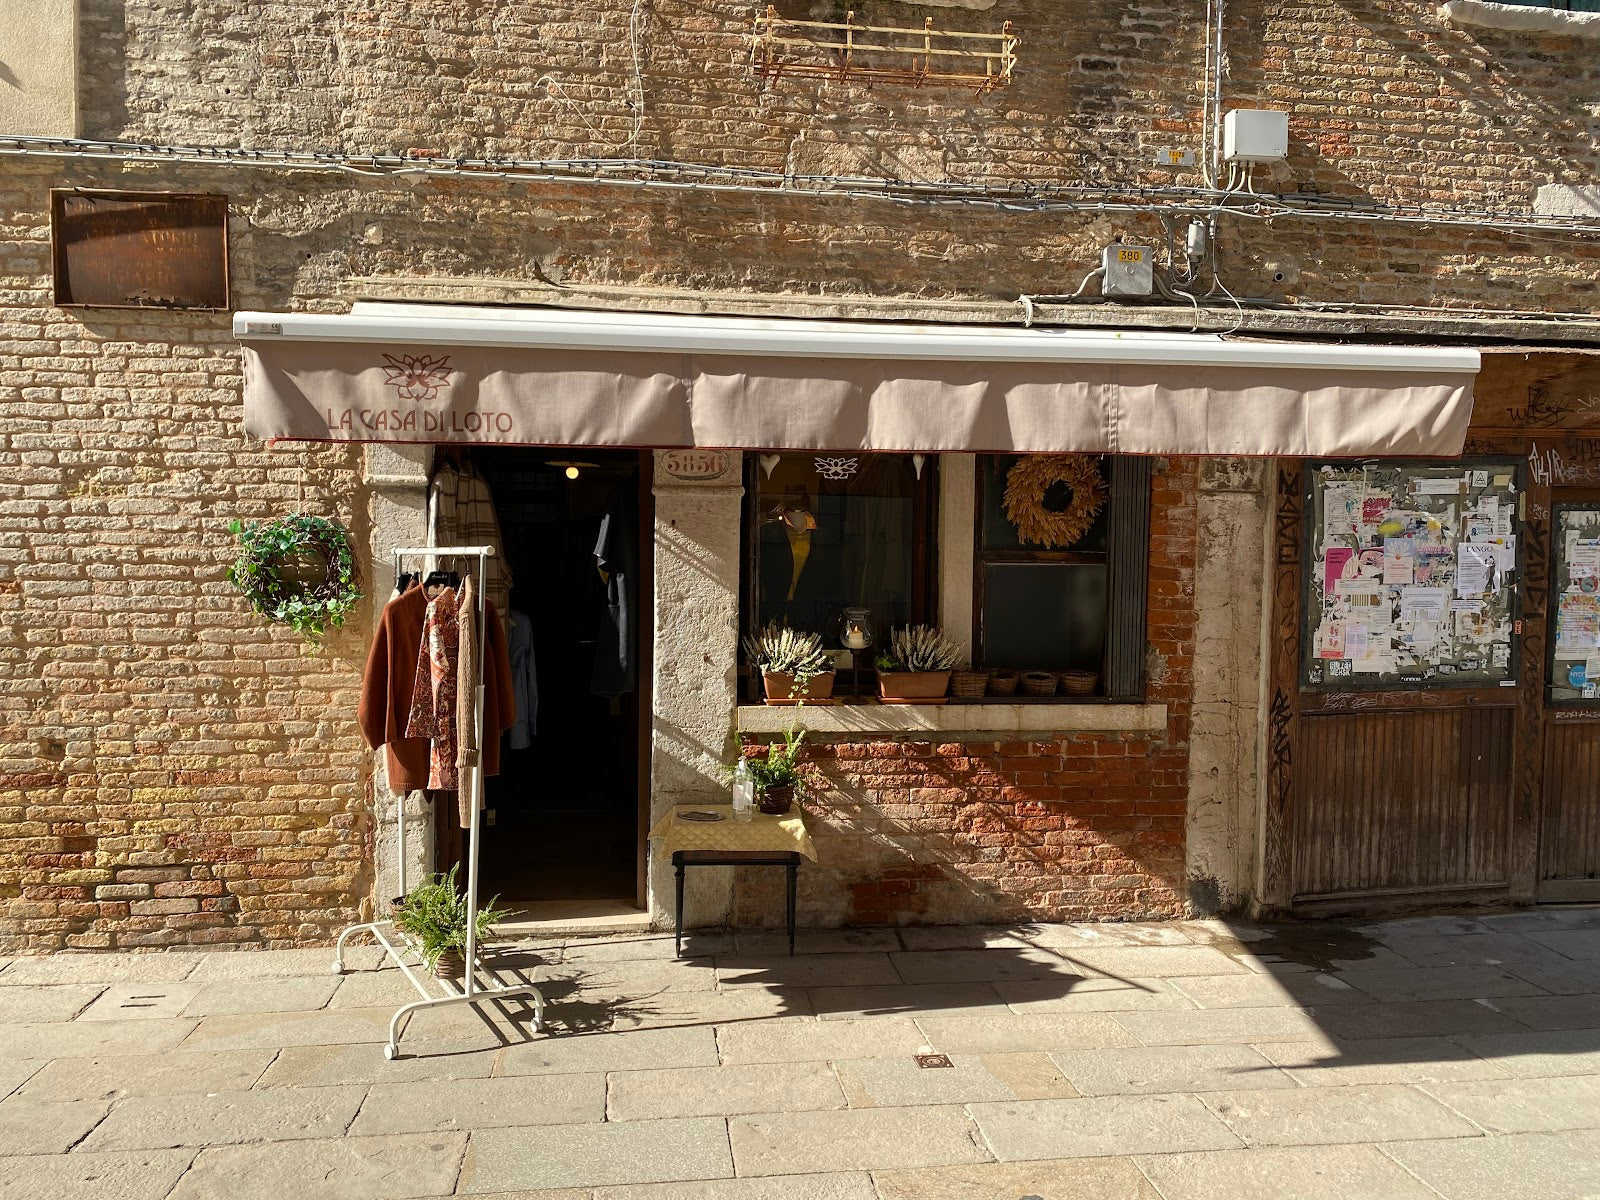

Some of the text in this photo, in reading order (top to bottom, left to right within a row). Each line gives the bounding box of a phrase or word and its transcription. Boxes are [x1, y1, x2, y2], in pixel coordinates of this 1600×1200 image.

[327, 408, 513, 433] LA CASA DI LOTO
[668, 453, 723, 472] 5856
